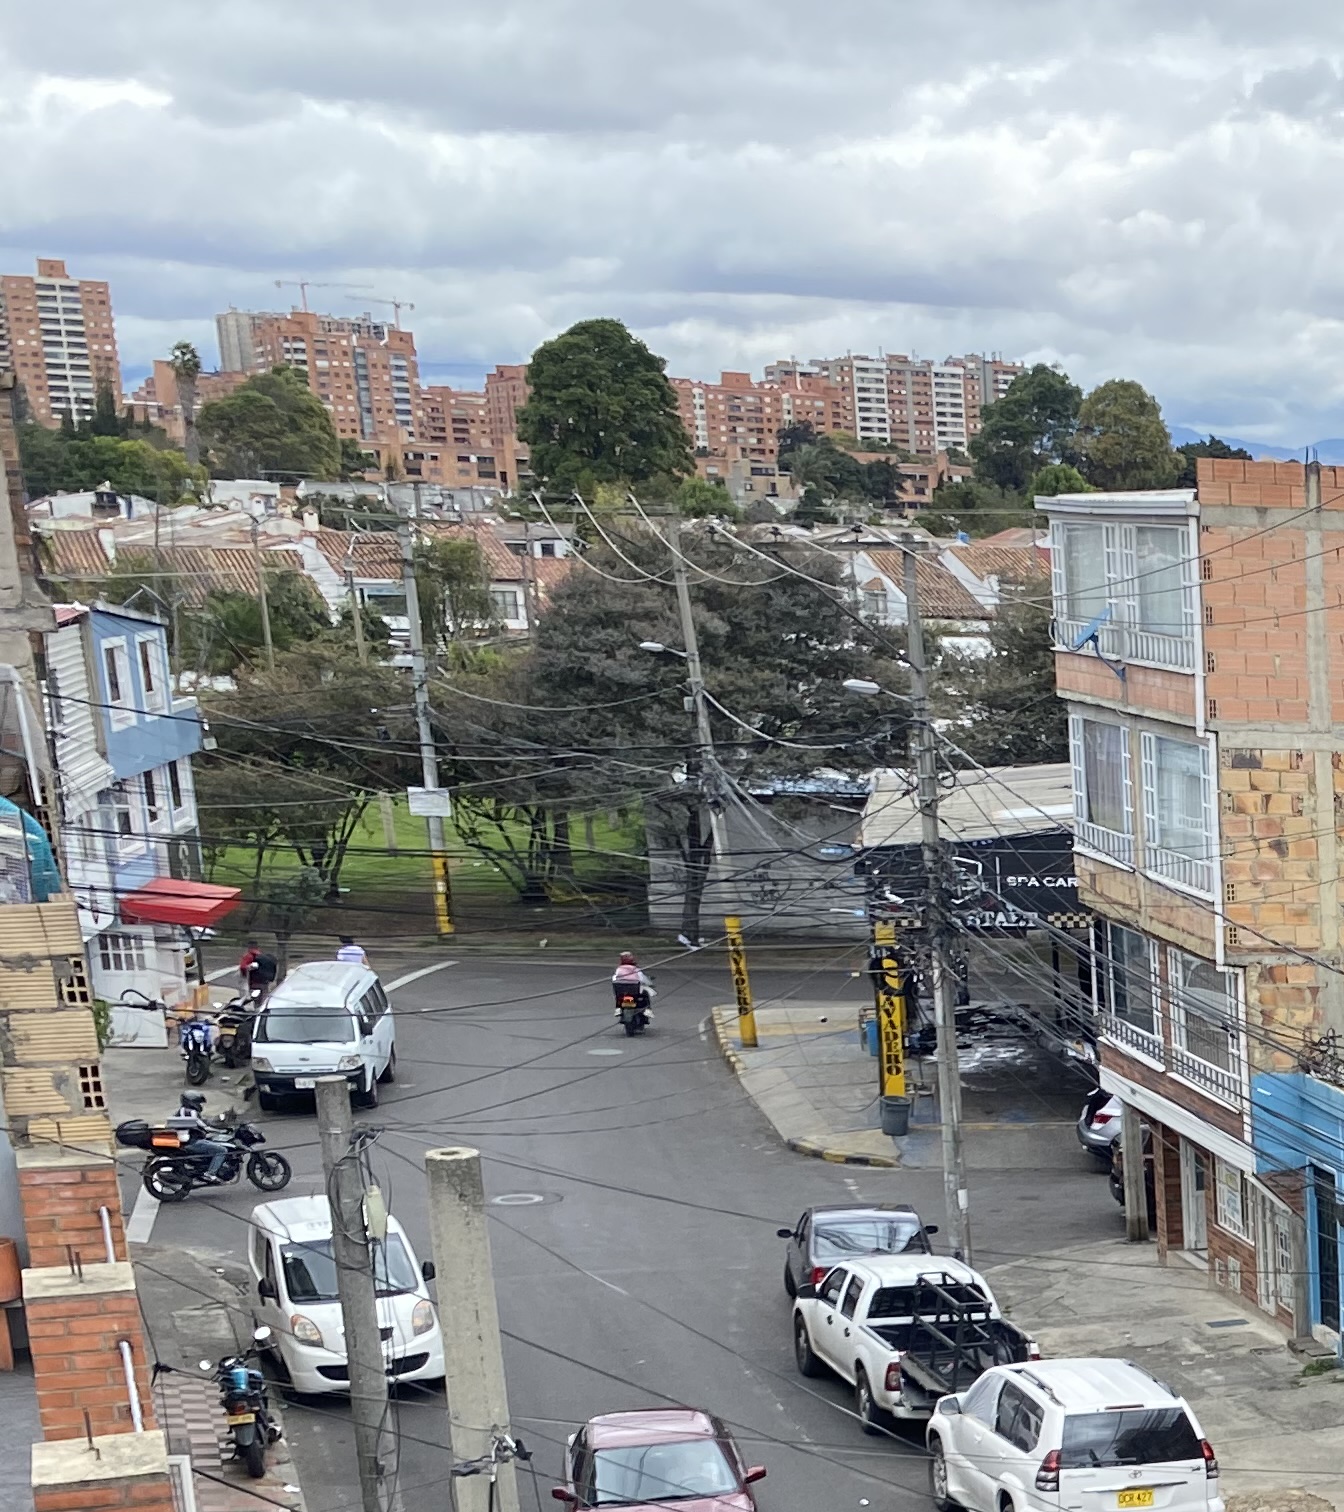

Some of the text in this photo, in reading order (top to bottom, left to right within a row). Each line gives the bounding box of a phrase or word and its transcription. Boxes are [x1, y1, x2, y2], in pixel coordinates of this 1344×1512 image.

[1005, 875, 1079, 888] SPA CAR
[882, 996, 903, 1076] AVADERO
